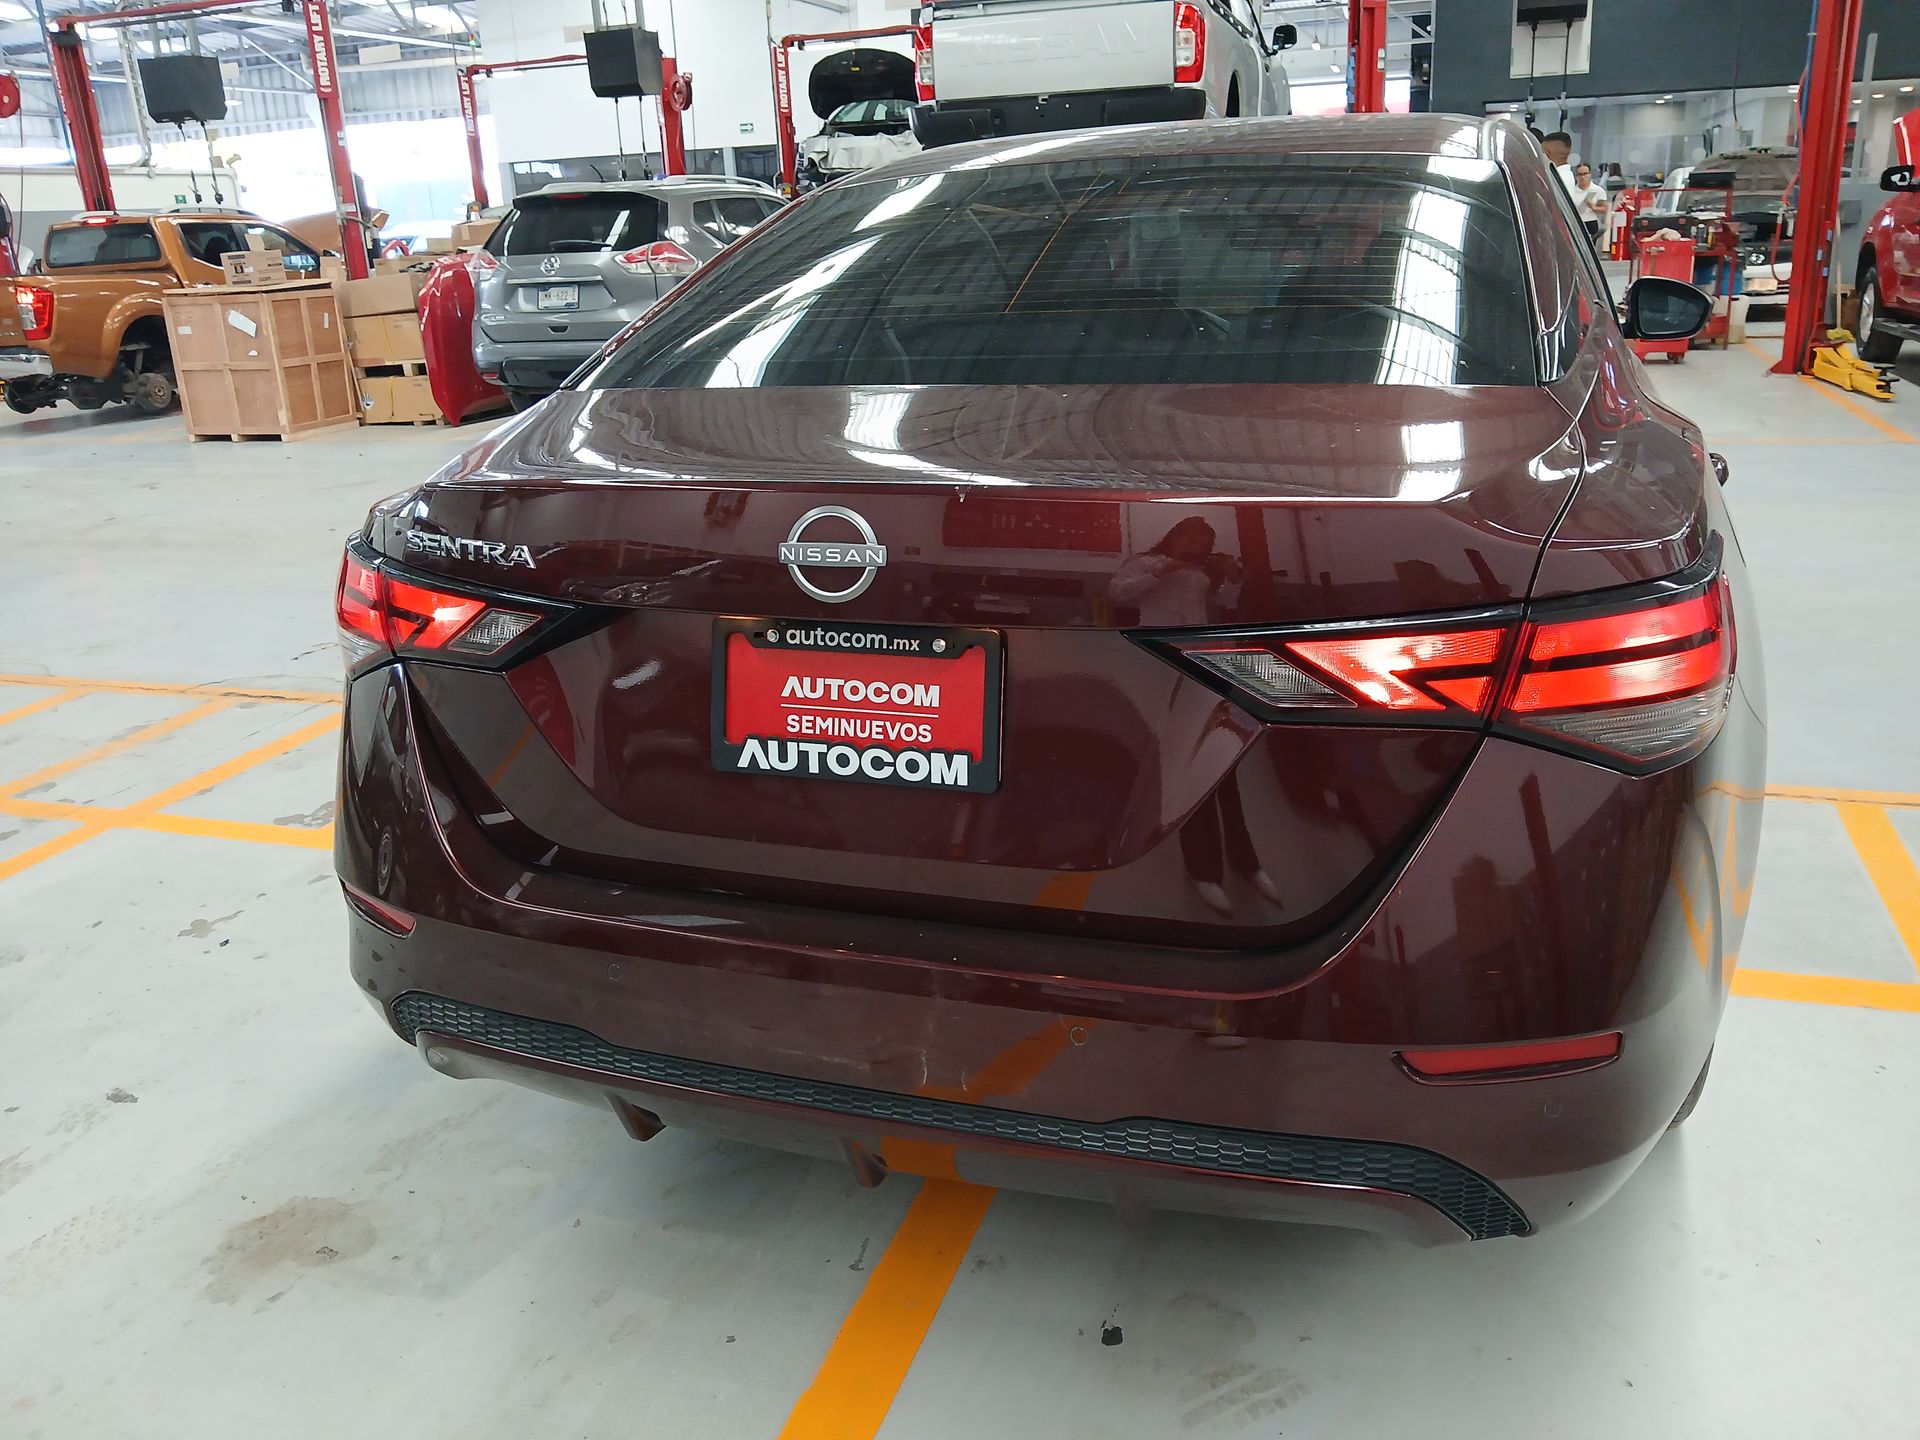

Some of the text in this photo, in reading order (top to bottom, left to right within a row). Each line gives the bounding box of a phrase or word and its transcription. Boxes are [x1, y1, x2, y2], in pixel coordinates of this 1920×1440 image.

[308, 3, 331, 86] ROTARY LIFT
[778, 68, 789, 108] ROTARY
[406, 529, 537, 569] SENTRA
[781, 547, 883, 564] NISSAN
[785, 627, 920, 651] autocom.mx
[781, 676, 940, 708] AUTOCOM
[786, 714, 932, 743] SEMINUEVOS
[737, 738, 969, 787] AUTOCOM
